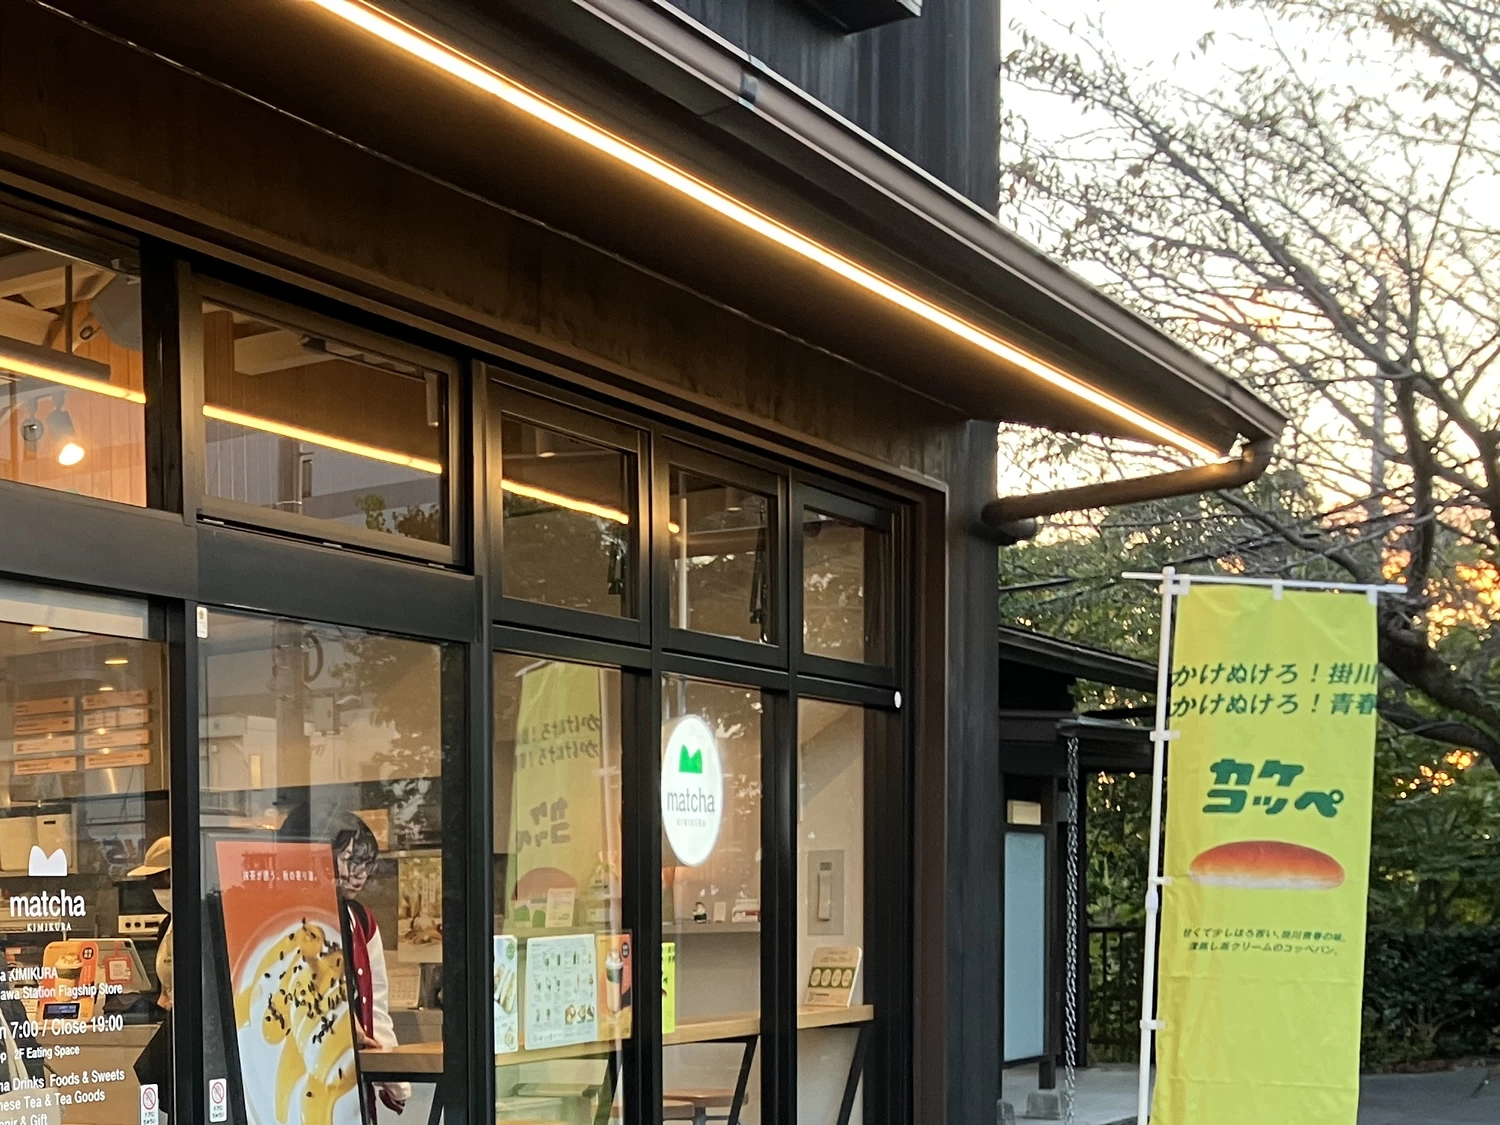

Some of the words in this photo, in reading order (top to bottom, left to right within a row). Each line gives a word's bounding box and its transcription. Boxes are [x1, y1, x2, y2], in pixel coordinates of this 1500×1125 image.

[1171, 662, 1378, 686] かけぬけろ！掛川
[1169, 693, 1377, 717] かけぬけろ！青春
[1209, 758, 1304, 787] カケ
[666, 788, 715, 813] matcha
[1202, 789, 1344, 818] コッペ
[10, 889, 86, 917] matcha
[26, 922, 72, 932] KIMIKURA
[9, 966, 58, 982] KIMIKURA
[22, 986, 56, 1000] Station
[58, 984, 97, 1000] Flagship
[99, 983, 123, 995] Store
[11, 1020, 38, 1039] 7:00
[51, 1017, 87, 1036] Close
[91, 1014, 124, 1033] 19:00
[14, 1049, 24, 1060] 2F
[26, 1048, 52, 1060] Eating
[54, 1045, 80, 1058] Space
[12, 1076, 45, 1092] Drinks
[50, 1073, 80, 1087] Foods
[82, 1071, 89, 1083] &
[91, 1069, 125, 1083] Sweets
[23, 1096, 42, 1109] Tea
[44, 1094, 52, 1107] &
[54, 1092, 73, 1106] Tea
[74, 1089, 105, 1104] Goods
